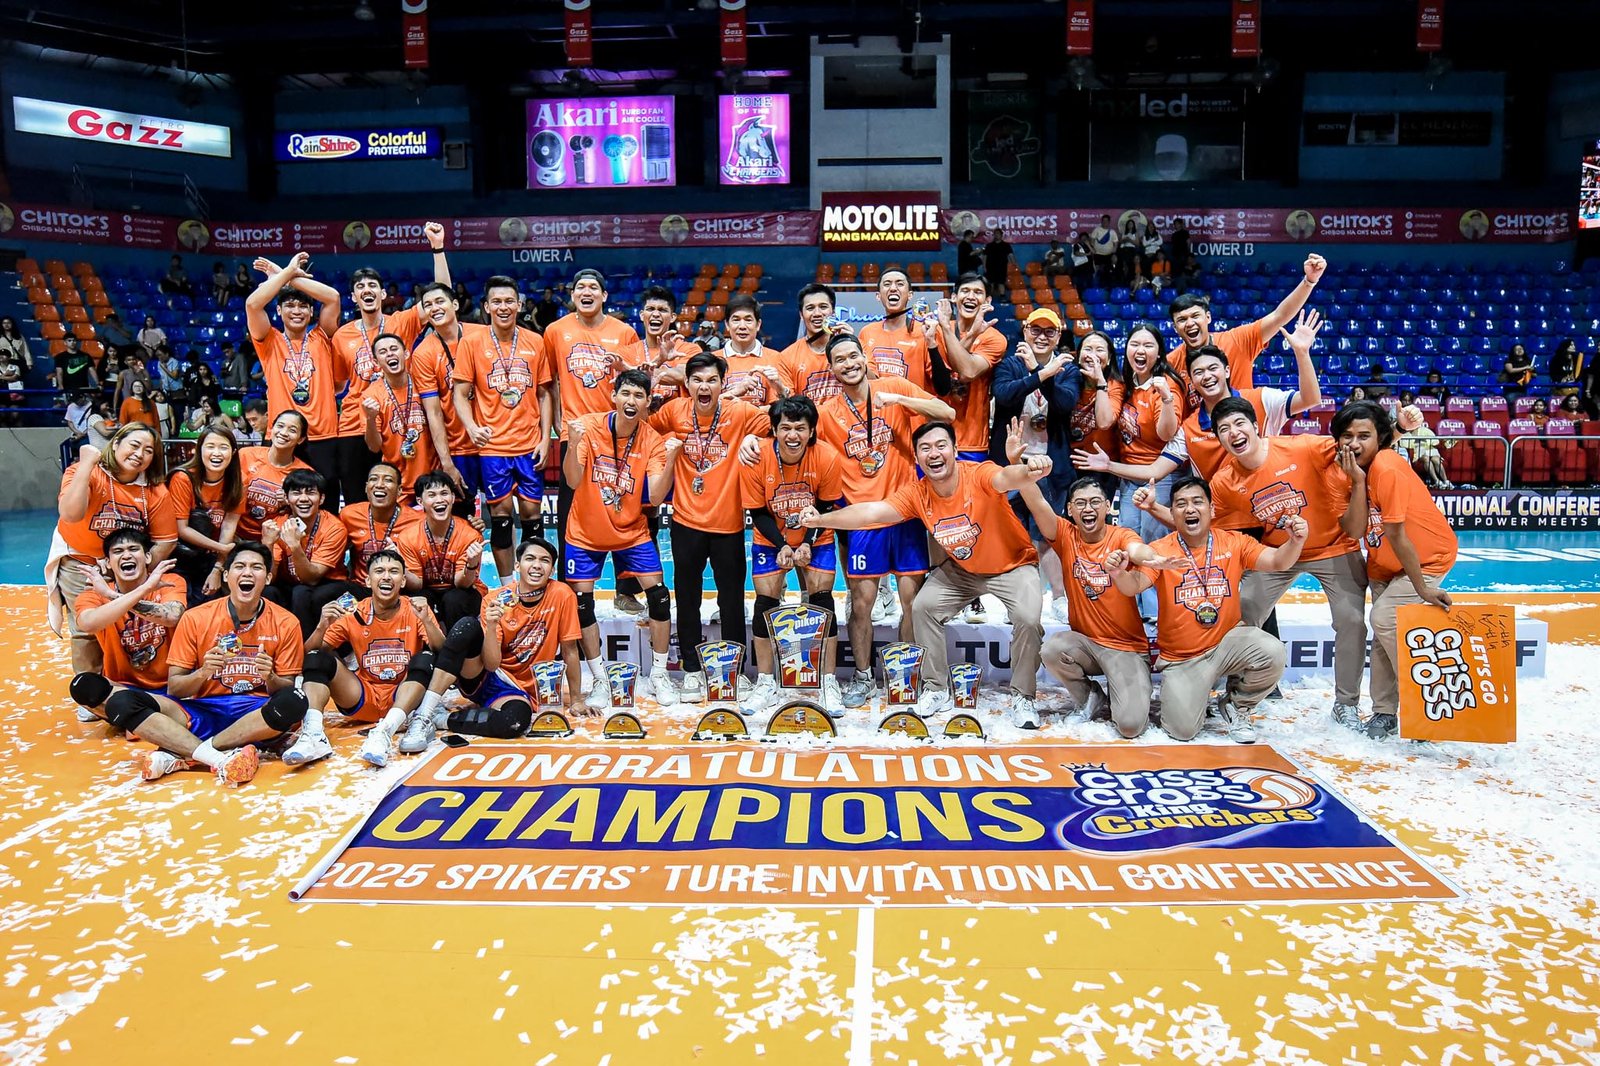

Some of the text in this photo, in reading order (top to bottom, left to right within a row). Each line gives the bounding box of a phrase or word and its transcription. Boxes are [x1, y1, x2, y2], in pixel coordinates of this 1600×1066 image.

[734, 97, 772, 107] HOME
[533, 101, 618, 127] Akari
[68, 109, 184, 148] Gazz
[140, 118, 184, 129] PETRO
[368, 131, 426, 146] Colorful
[368, 145, 426, 156] PROTECTION
[736, 156, 772, 166] Akari
[21, 209, 109, 230] CHITOK'S
[694, 218, 764, 232] CHITOK'S
[823, 205, 939, 231] MOTOLITE
[985, 215, 1058, 229] CHITOK'S
[1153, 215, 1225, 228] CHTOK'S
[1320, 215, 1393, 229] CHITOK'S
[1494, 213, 1568, 228] CHITOK'S
[214, 227, 283, 242] CHITOK'S
[375, 225, 426, 238] CHITO
[532, 220, 601, 235] CHITOK'S
[824, 232, 939, 242] PANGMATAGALAN
[512, 249, 573, 263] LOWER A
[1191, 242, 1254, 256] LOWER B
[569, 359, 605, 370] CHAMPION
[879, 364, 904, 376] MPIONS
[1256, 496, 1303, 520] CHAMPIONS
[1433, 496, 1600, 516] ATIONAL CONFERE
[1475, 518, 1528, 526] POWER
[1538, 518, 1588, 526] MEETS
[758, 553, 766, 564] 3
[851, 554, 866, 570] 16
[568, 559, 575, 574] 9
[365, 655, 408, 666] CHAMPIONS
[1469, 636, 1498, 705] LET'S GO
[433, 752, 1052, 783] CONGRATULATIONS
[372, 787, 1046, 843] CHAMPIONS
[1136, 803, 1214, 817] King
[1094, 808, 1318, 834] Crunchers
[316, 861, 434, 888] 2025
[437, 864, 650, 890] SPIKERS'
[792, 864, 1114, 892] INVITATIONAL
[1117, 860, 1430, 890] CONFERENCE
